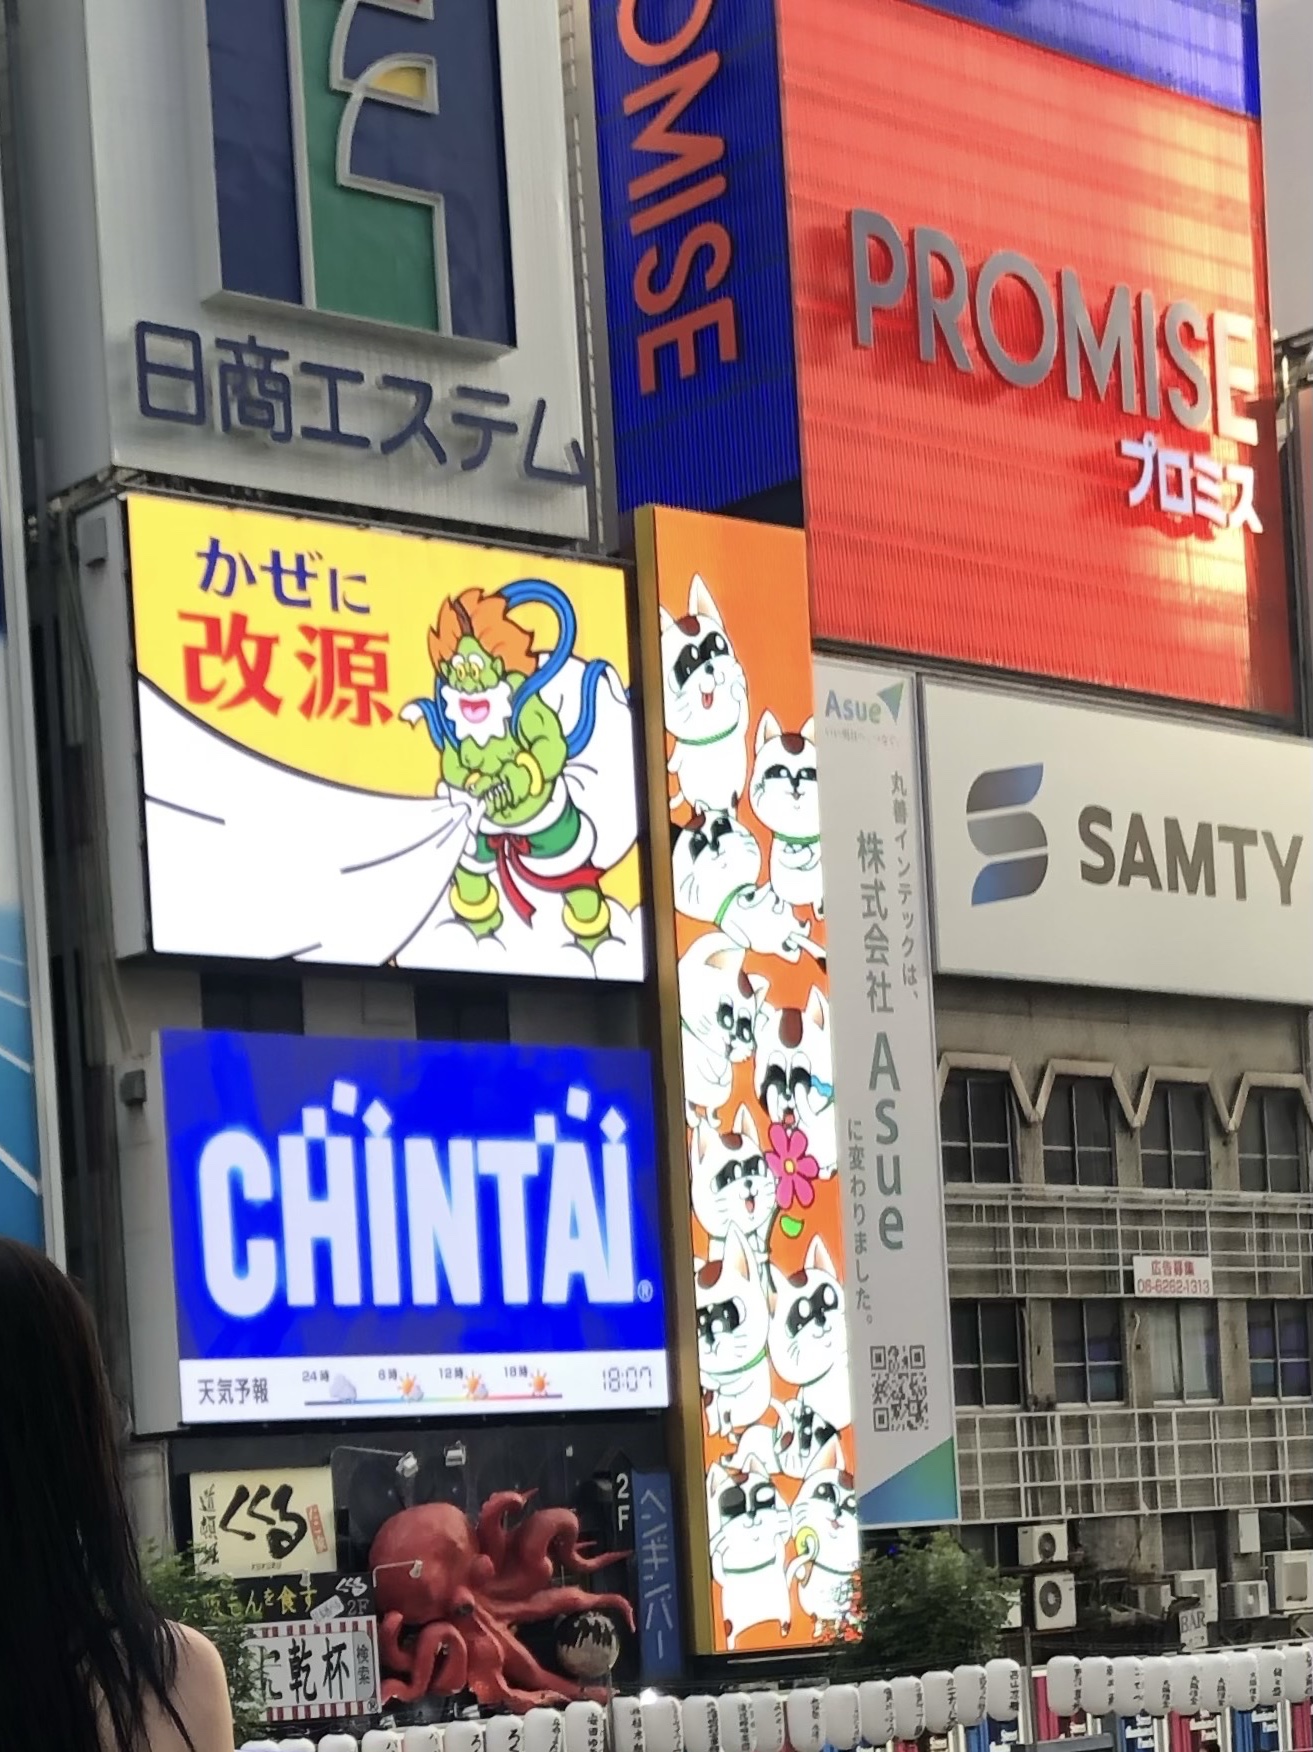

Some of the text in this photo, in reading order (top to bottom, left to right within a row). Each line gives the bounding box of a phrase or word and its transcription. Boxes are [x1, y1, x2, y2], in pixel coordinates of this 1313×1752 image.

[847, 208, 1259, 446] PROMISE
[136, 320, 586, 486] 日商エステム
[1121, 432, 1263, 534] プロミス
[196, 537, 371, 614] かぜに
[178, 610, 394, 726] 改源
[825, 689, 881, 724] Asue
[1077, 804, 1303, 906] SAMTY
[198, 1082, 634, 1318] CHINTAI
[198, 1377, 269, 1405] 天気予報
[602, 1366, 652, 1393] 18:07
[219, 1484, 308, 1559] くくる
[616, 1473, 630, 1531] 2F
[347, 1599, 369, 1616] 2F
[1180, 1610, 1206, 1634] BAR
